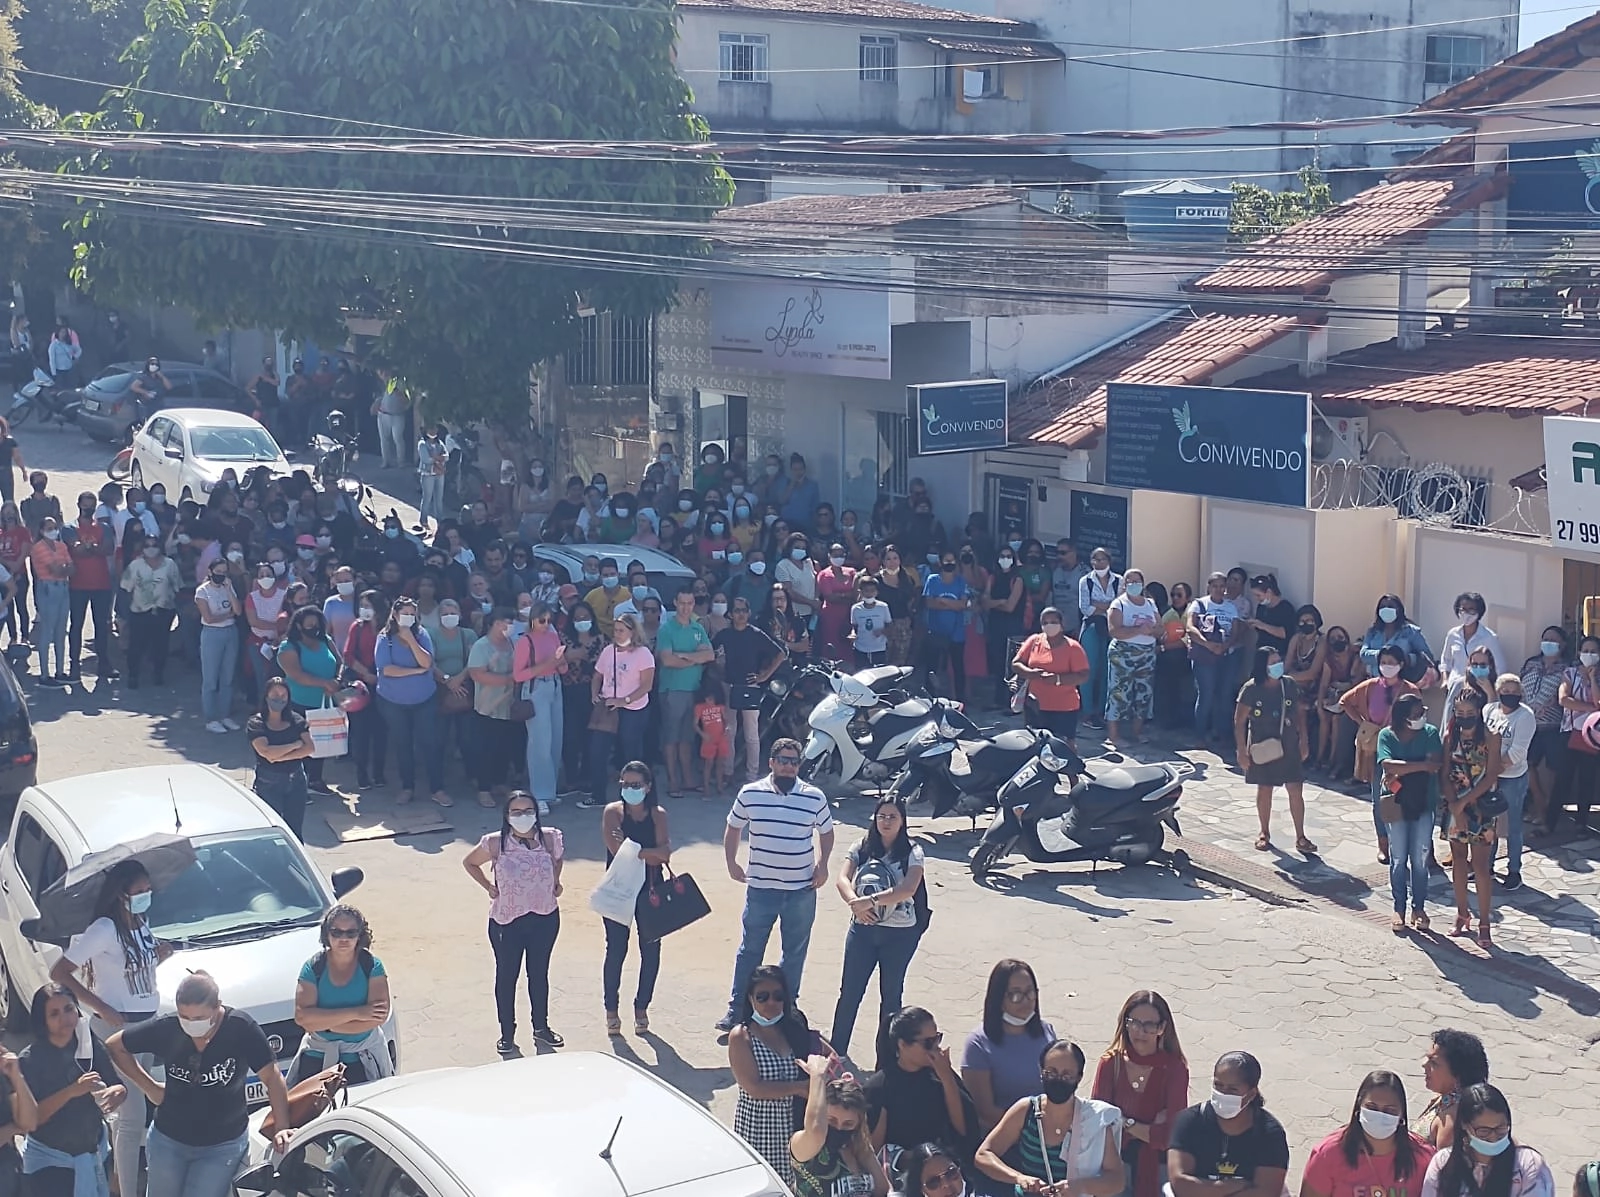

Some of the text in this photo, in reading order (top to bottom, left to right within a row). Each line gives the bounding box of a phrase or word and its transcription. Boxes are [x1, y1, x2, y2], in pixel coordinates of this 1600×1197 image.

[765, 297, 816, 358] Lynda
[1178, 432, 1302, 472] CONVIVENDO
[1557, 520, 1600, 545] 27 99
